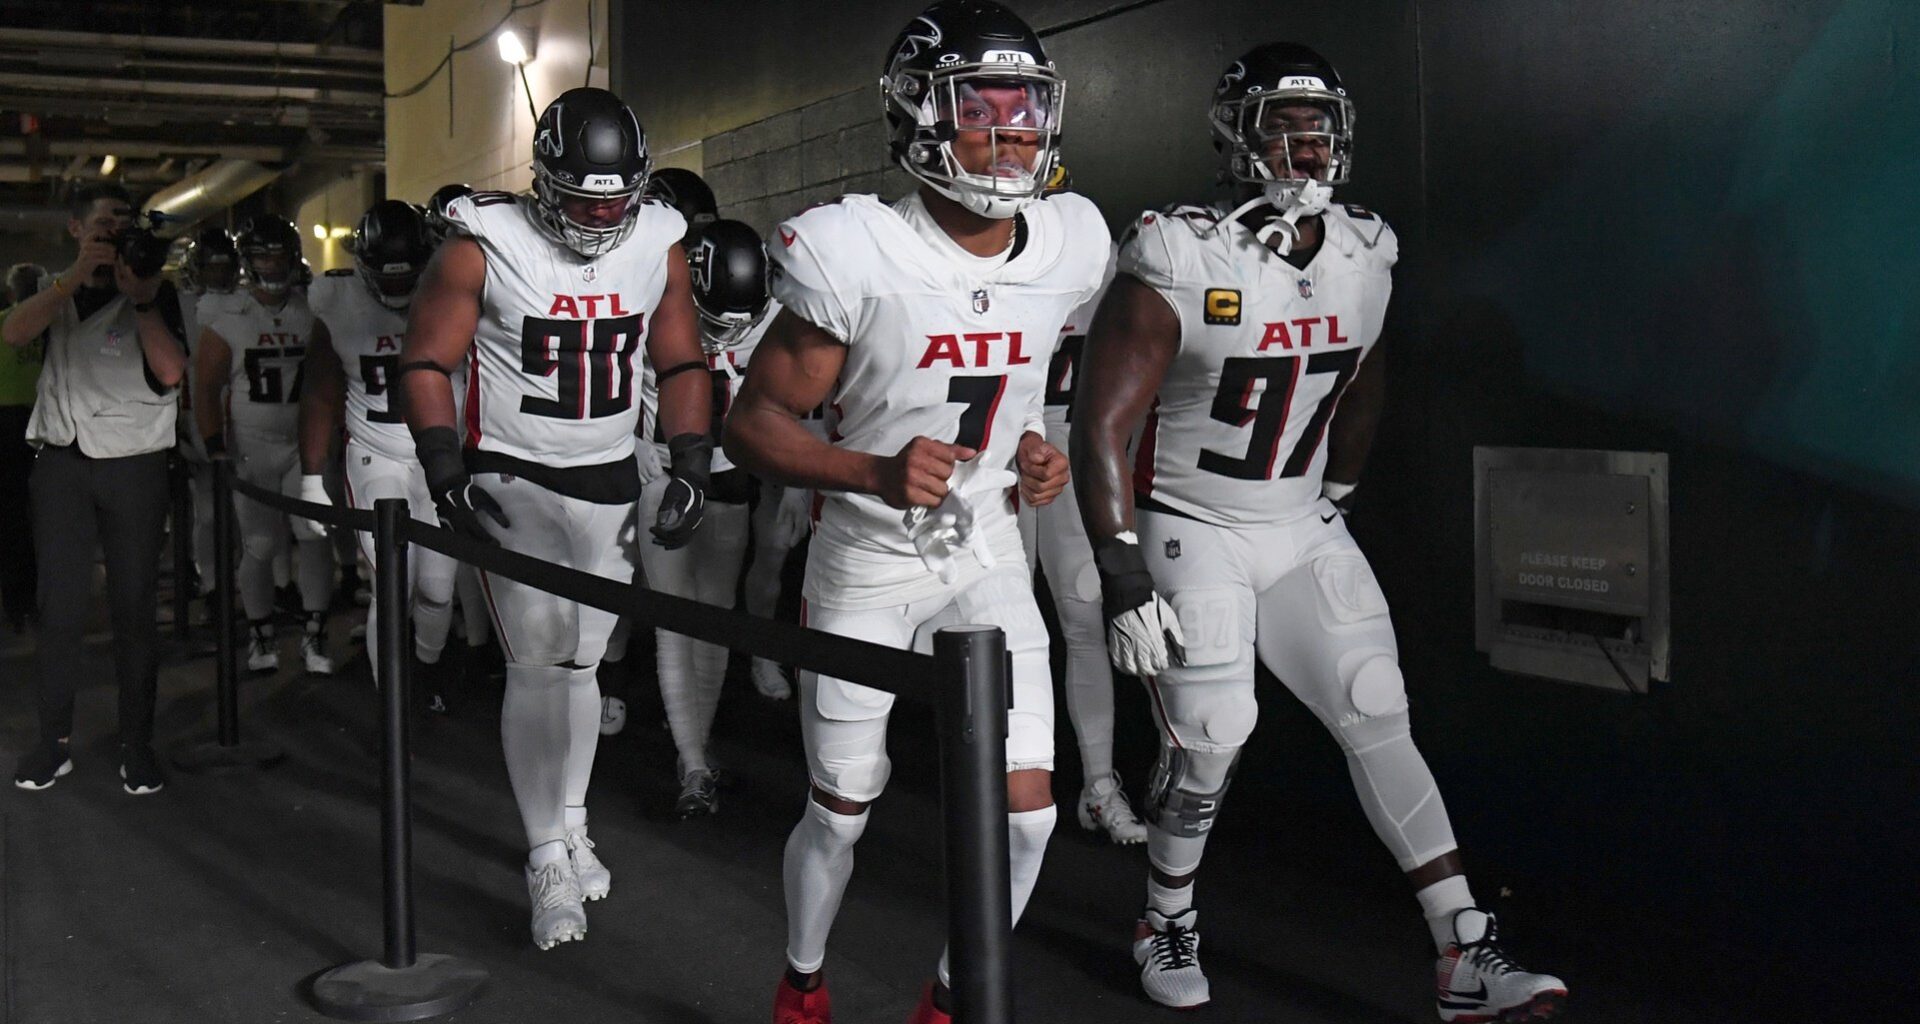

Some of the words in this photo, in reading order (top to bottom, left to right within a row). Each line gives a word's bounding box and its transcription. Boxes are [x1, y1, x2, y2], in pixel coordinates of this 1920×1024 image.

[997, 53, 1025, 63] ATL
[549, 293, 629, 318] ATL
[1207, 290, 1240, 317] C
[258, 332, 300, 346] ATL
[916, 331, 1032, 369] ATL
[1257, 315, 1348, 351] ATL
[244, 347, 305, 403] 67
[519, 313, 645, 420] 90
[360, 354, 406, 423] 9
[946, 374, 1008, 453] 7
[1197, 346, 1363, 480] 97
[1519, 551, 1568, 568] PLEASE
[1572, 556, 1606, 571] KEEP
[1518, 573, 1554, 587] DOOR
[1557, 576, 1609, 593] CLOSED
